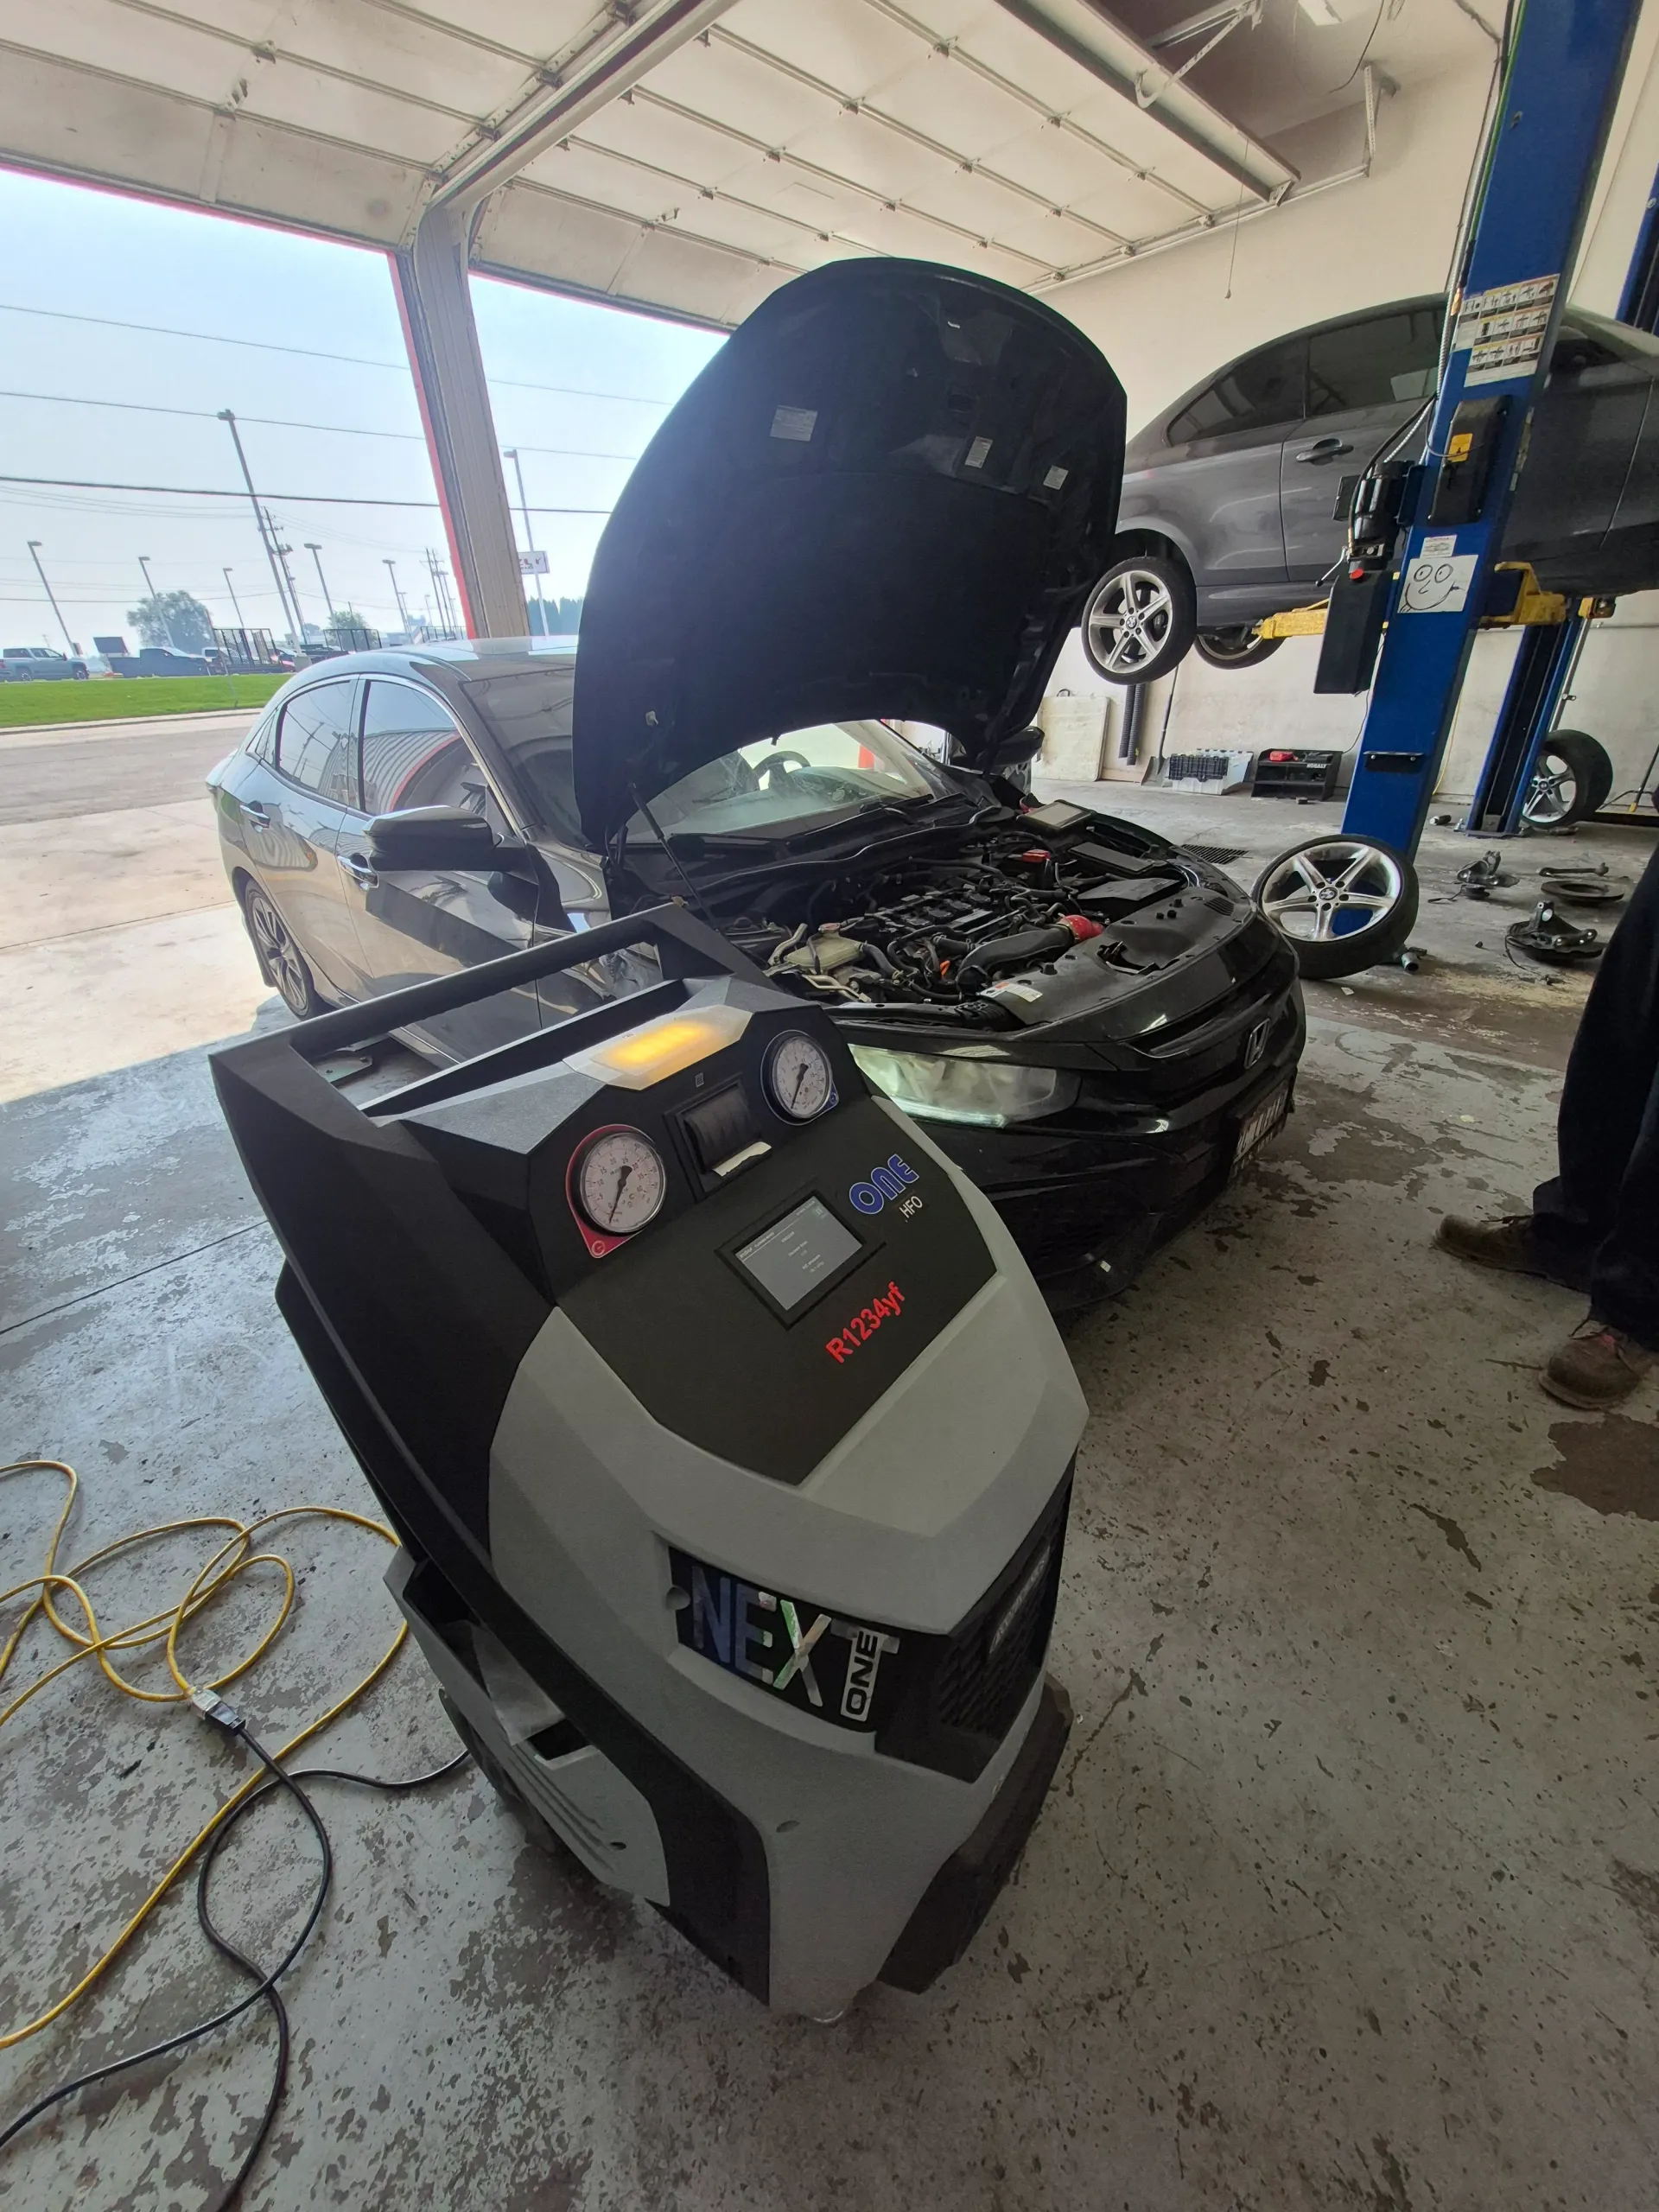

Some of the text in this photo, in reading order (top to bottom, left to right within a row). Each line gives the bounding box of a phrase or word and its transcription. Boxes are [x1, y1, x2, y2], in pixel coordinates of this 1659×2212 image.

[596, 1179, 604, 1187] 10
[849, 1154, 919, 1214] ONE
[899, 1196, 922, 1218] HFO
[826, 1281, 905, 1363] R1234yf
[844, 1630, 878, 1715] ONE
